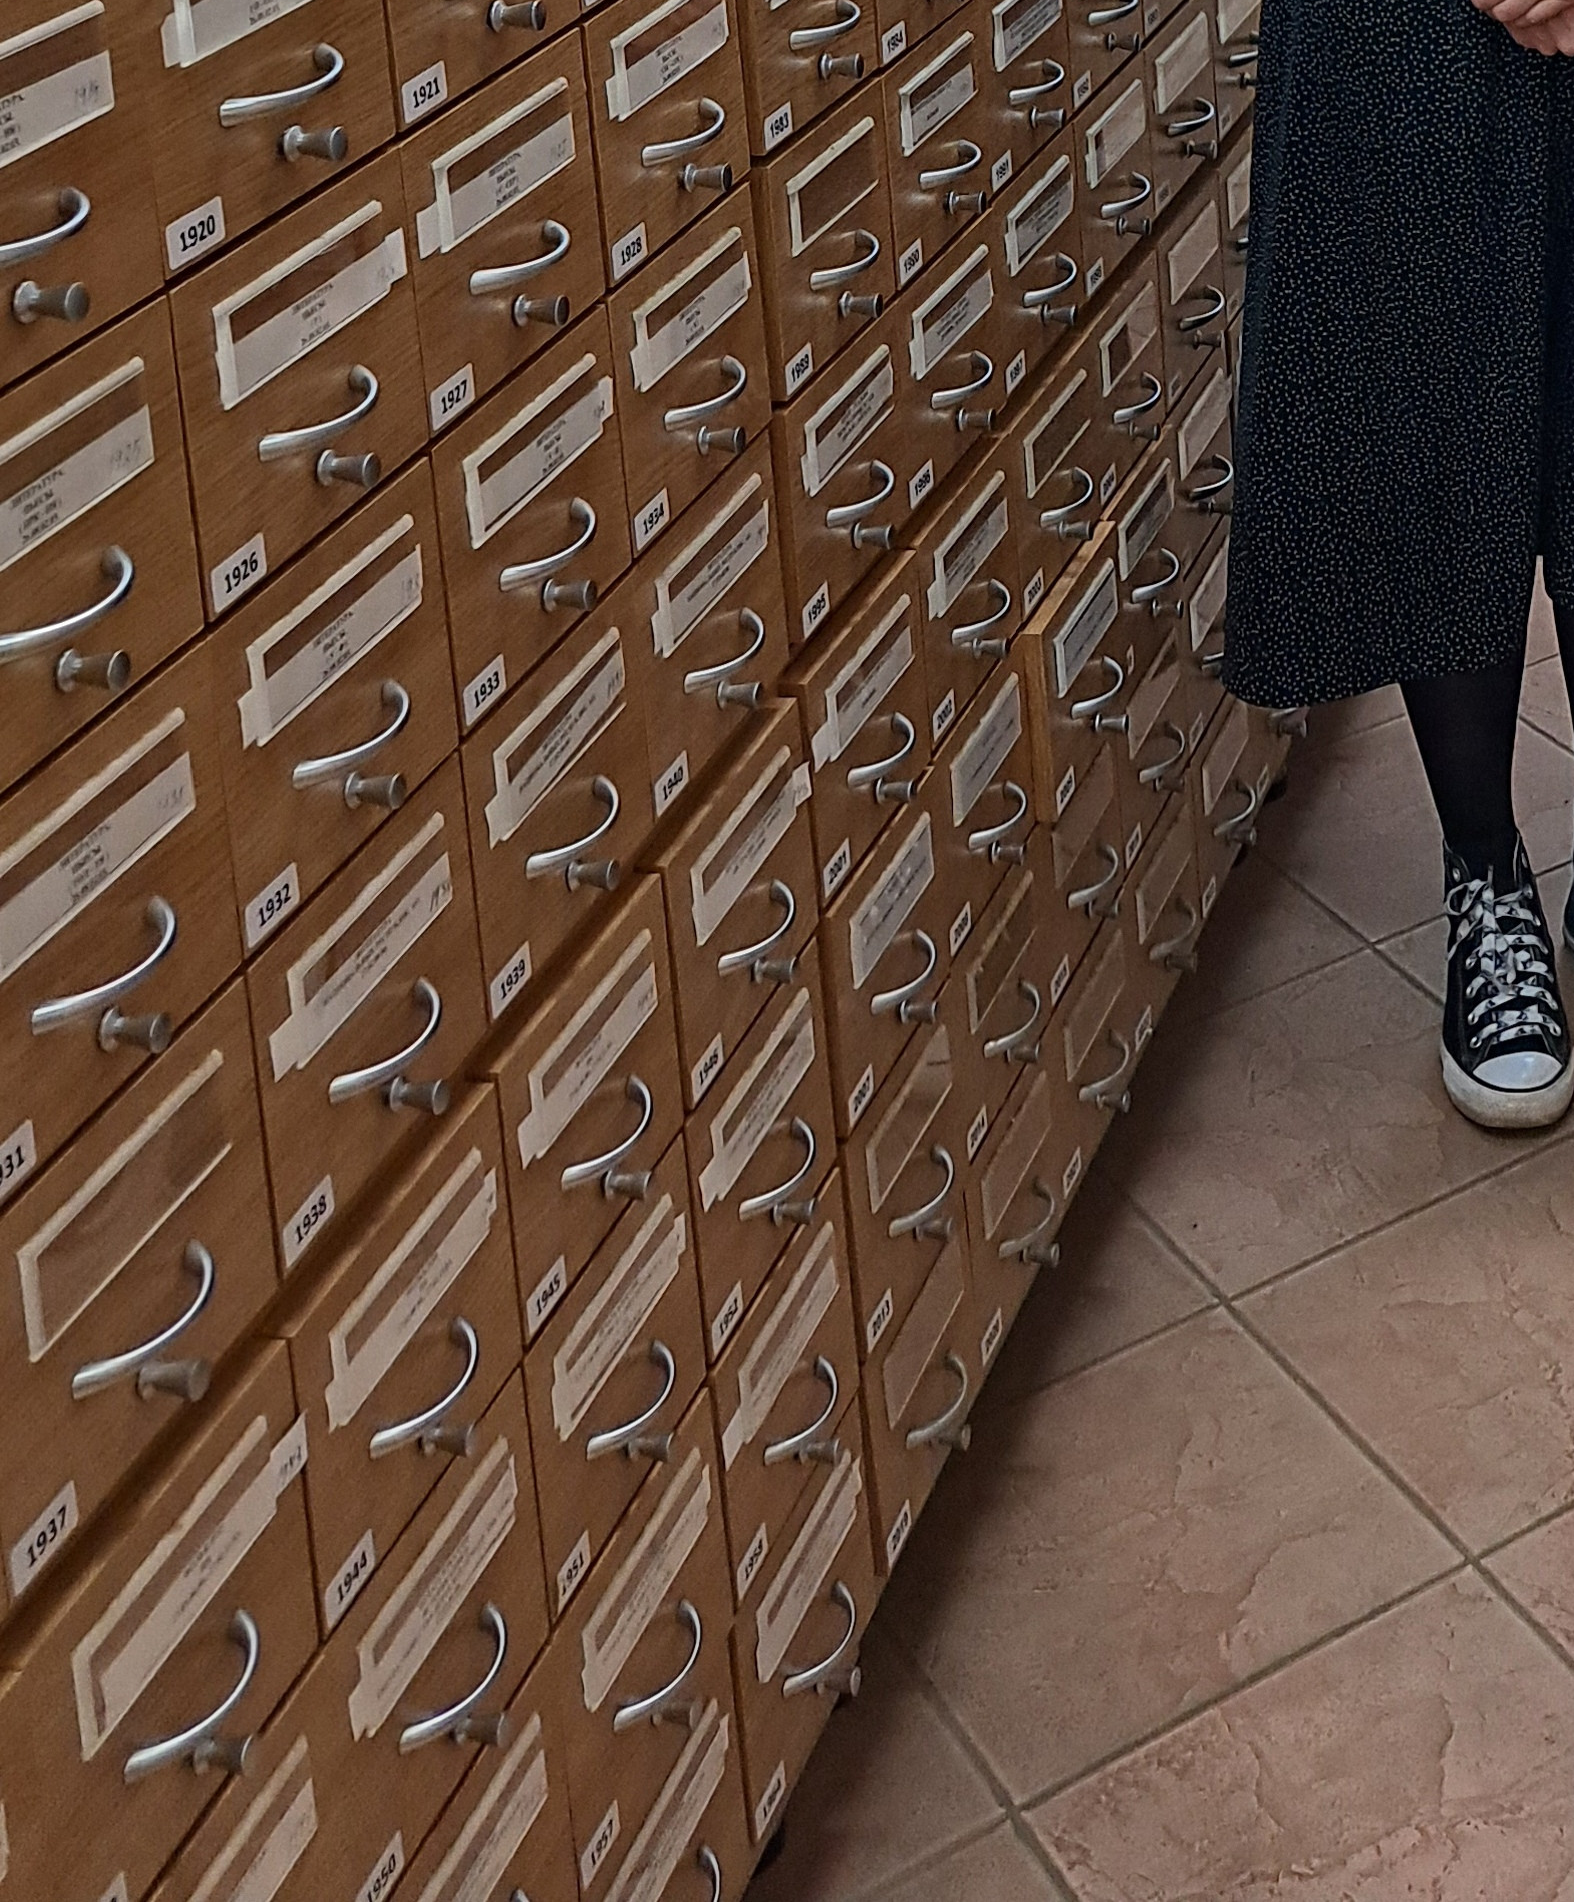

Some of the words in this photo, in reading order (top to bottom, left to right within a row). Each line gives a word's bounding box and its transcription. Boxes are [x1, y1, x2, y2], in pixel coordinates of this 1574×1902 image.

[413, 77, 440, 108] 1921
[180, 215, 215, 252] 1920
[621, 236, 642, 265] 1928
[441, 380, 467, 414] 1927
[643, 502, 664, 535] 1934
[225, 551, 258, 593] 1926
[808, 593, 826, 624] 1995
[474, 671, 500, 708] 1933
[663, 766, 683, 800] 1940
[259, 883, 291, 927] 1932
[501, 959, 525, 999] 1939
[700, 1049, 718, 1085] 1946
[296, 1195, 326, 1244] 1938
[537, 1273, 560, 1316] 1945
[28, 1505, 66, 1567] 1937
[338, 1551, 367, 1603] 1944
[562, 1552, 584, 1596] 1951
[591, 1819, 613, 1866] 1957
[367, 1853, 396, 1902] 1950
